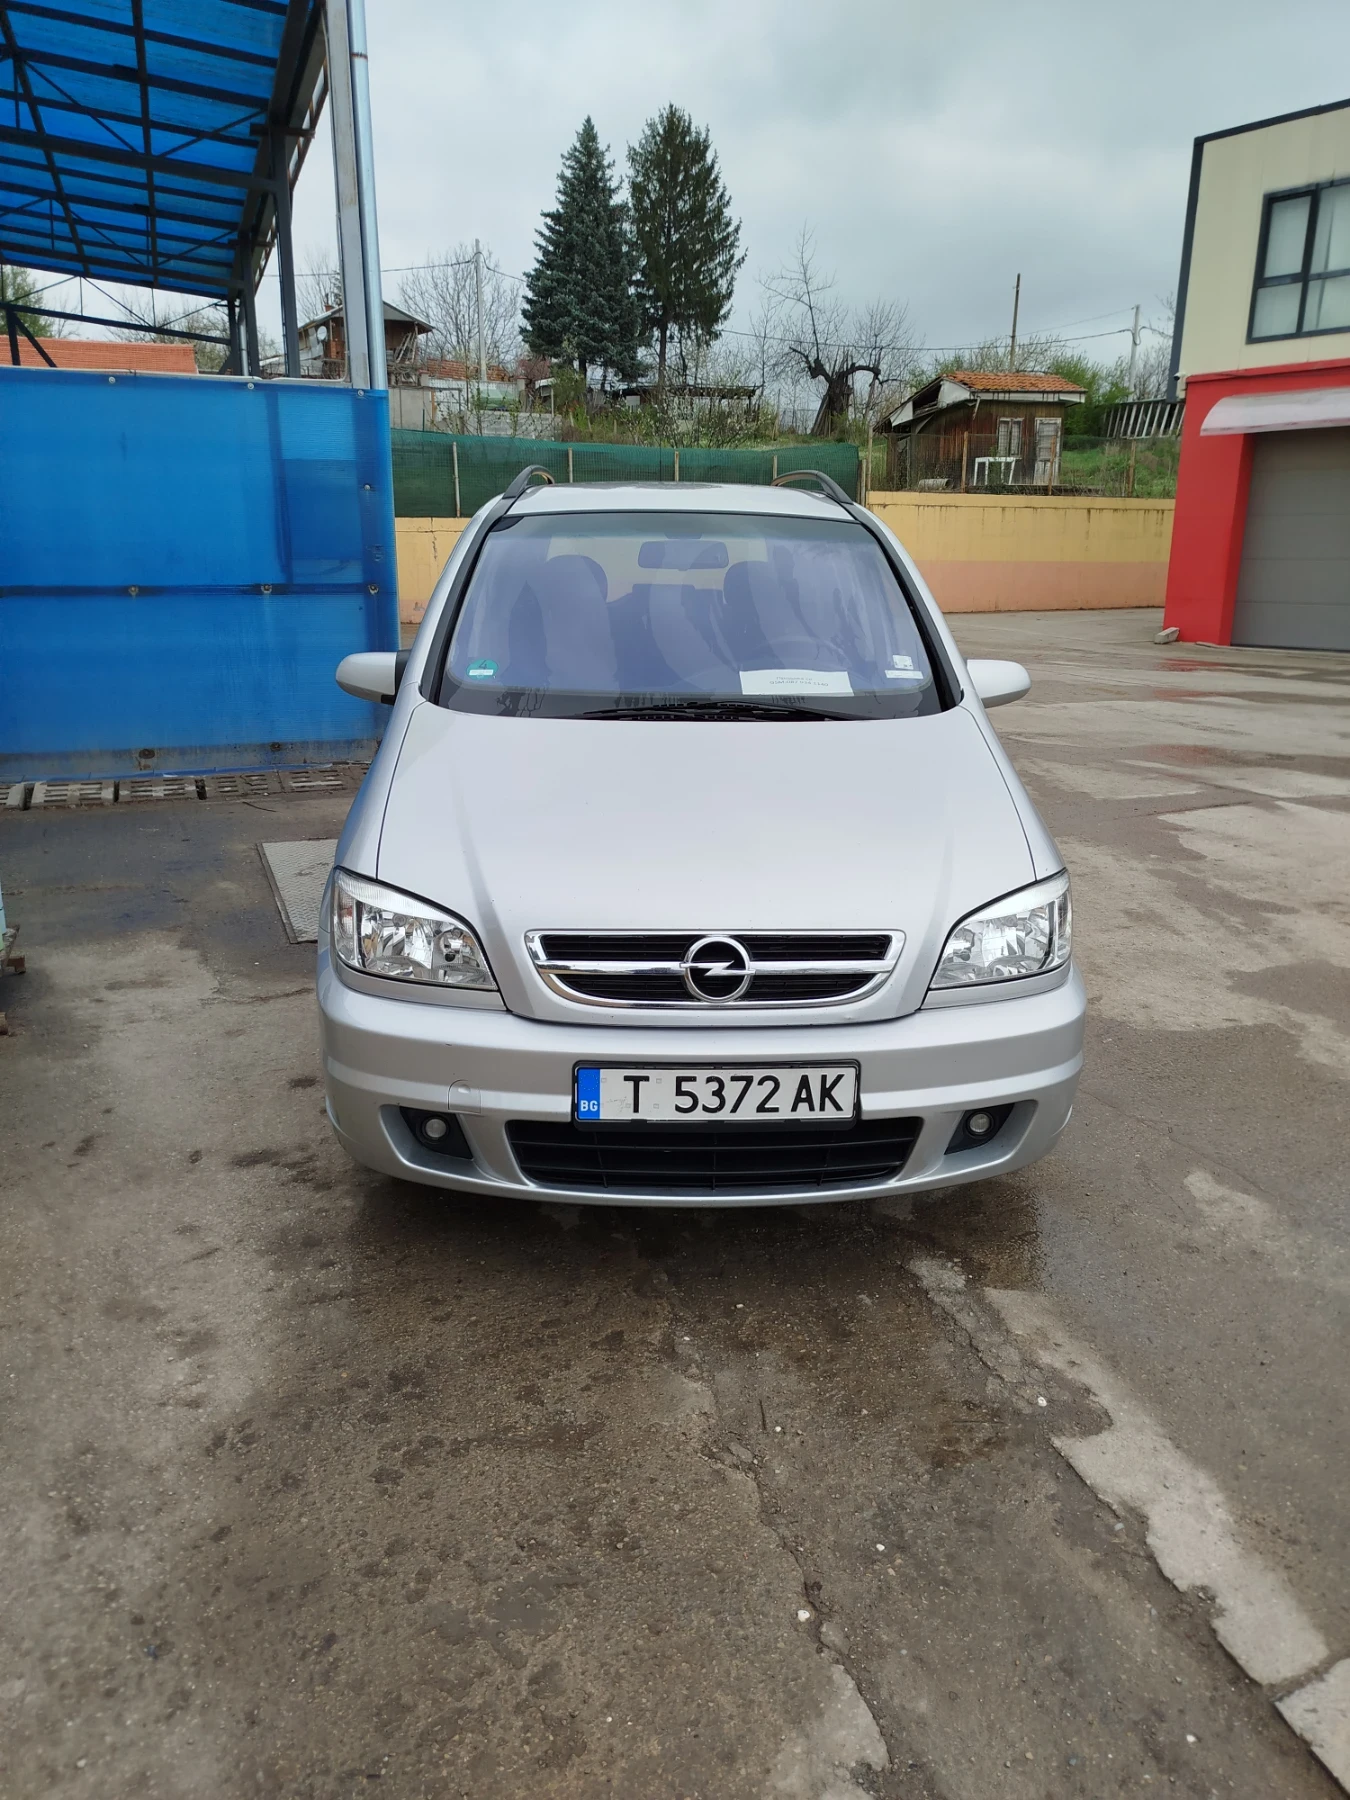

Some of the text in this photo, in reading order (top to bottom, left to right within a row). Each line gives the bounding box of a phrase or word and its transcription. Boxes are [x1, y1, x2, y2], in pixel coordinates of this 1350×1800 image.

[478, 659, 488, 670] 4
[623, 1073, 845, 1114] T 5372 AK
[580, 1100, 598, 1112] BG
